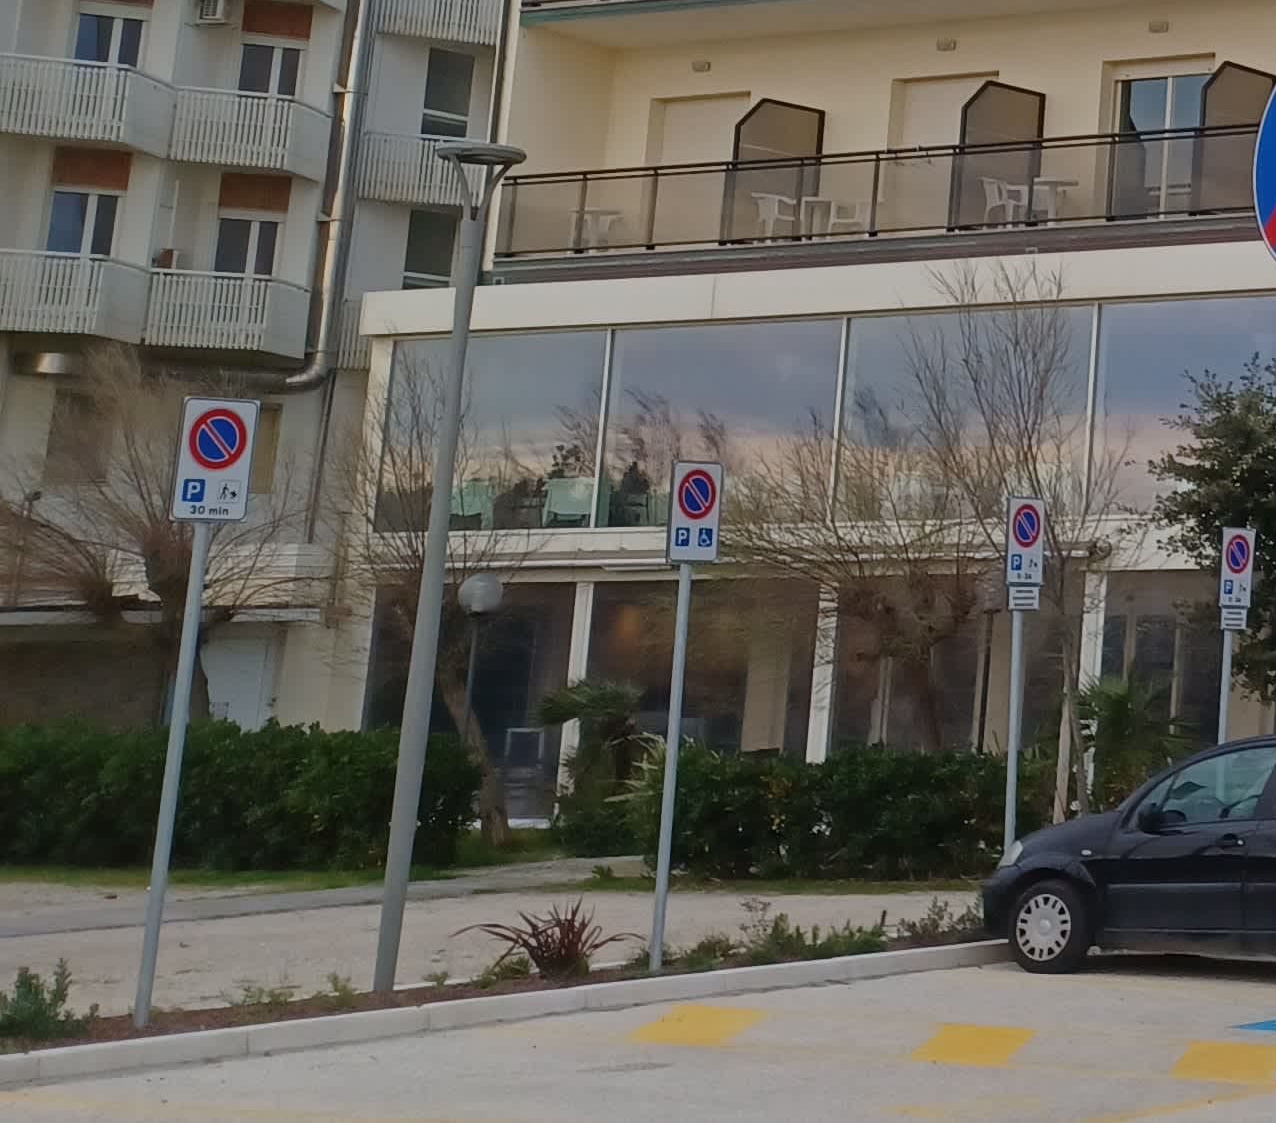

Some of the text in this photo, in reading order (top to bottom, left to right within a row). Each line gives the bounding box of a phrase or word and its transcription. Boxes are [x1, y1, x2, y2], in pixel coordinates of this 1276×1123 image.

[185, 481, 201, 500] P
[189, 505, 229, 516] 30 min
[678, 529, 688, 545] P
